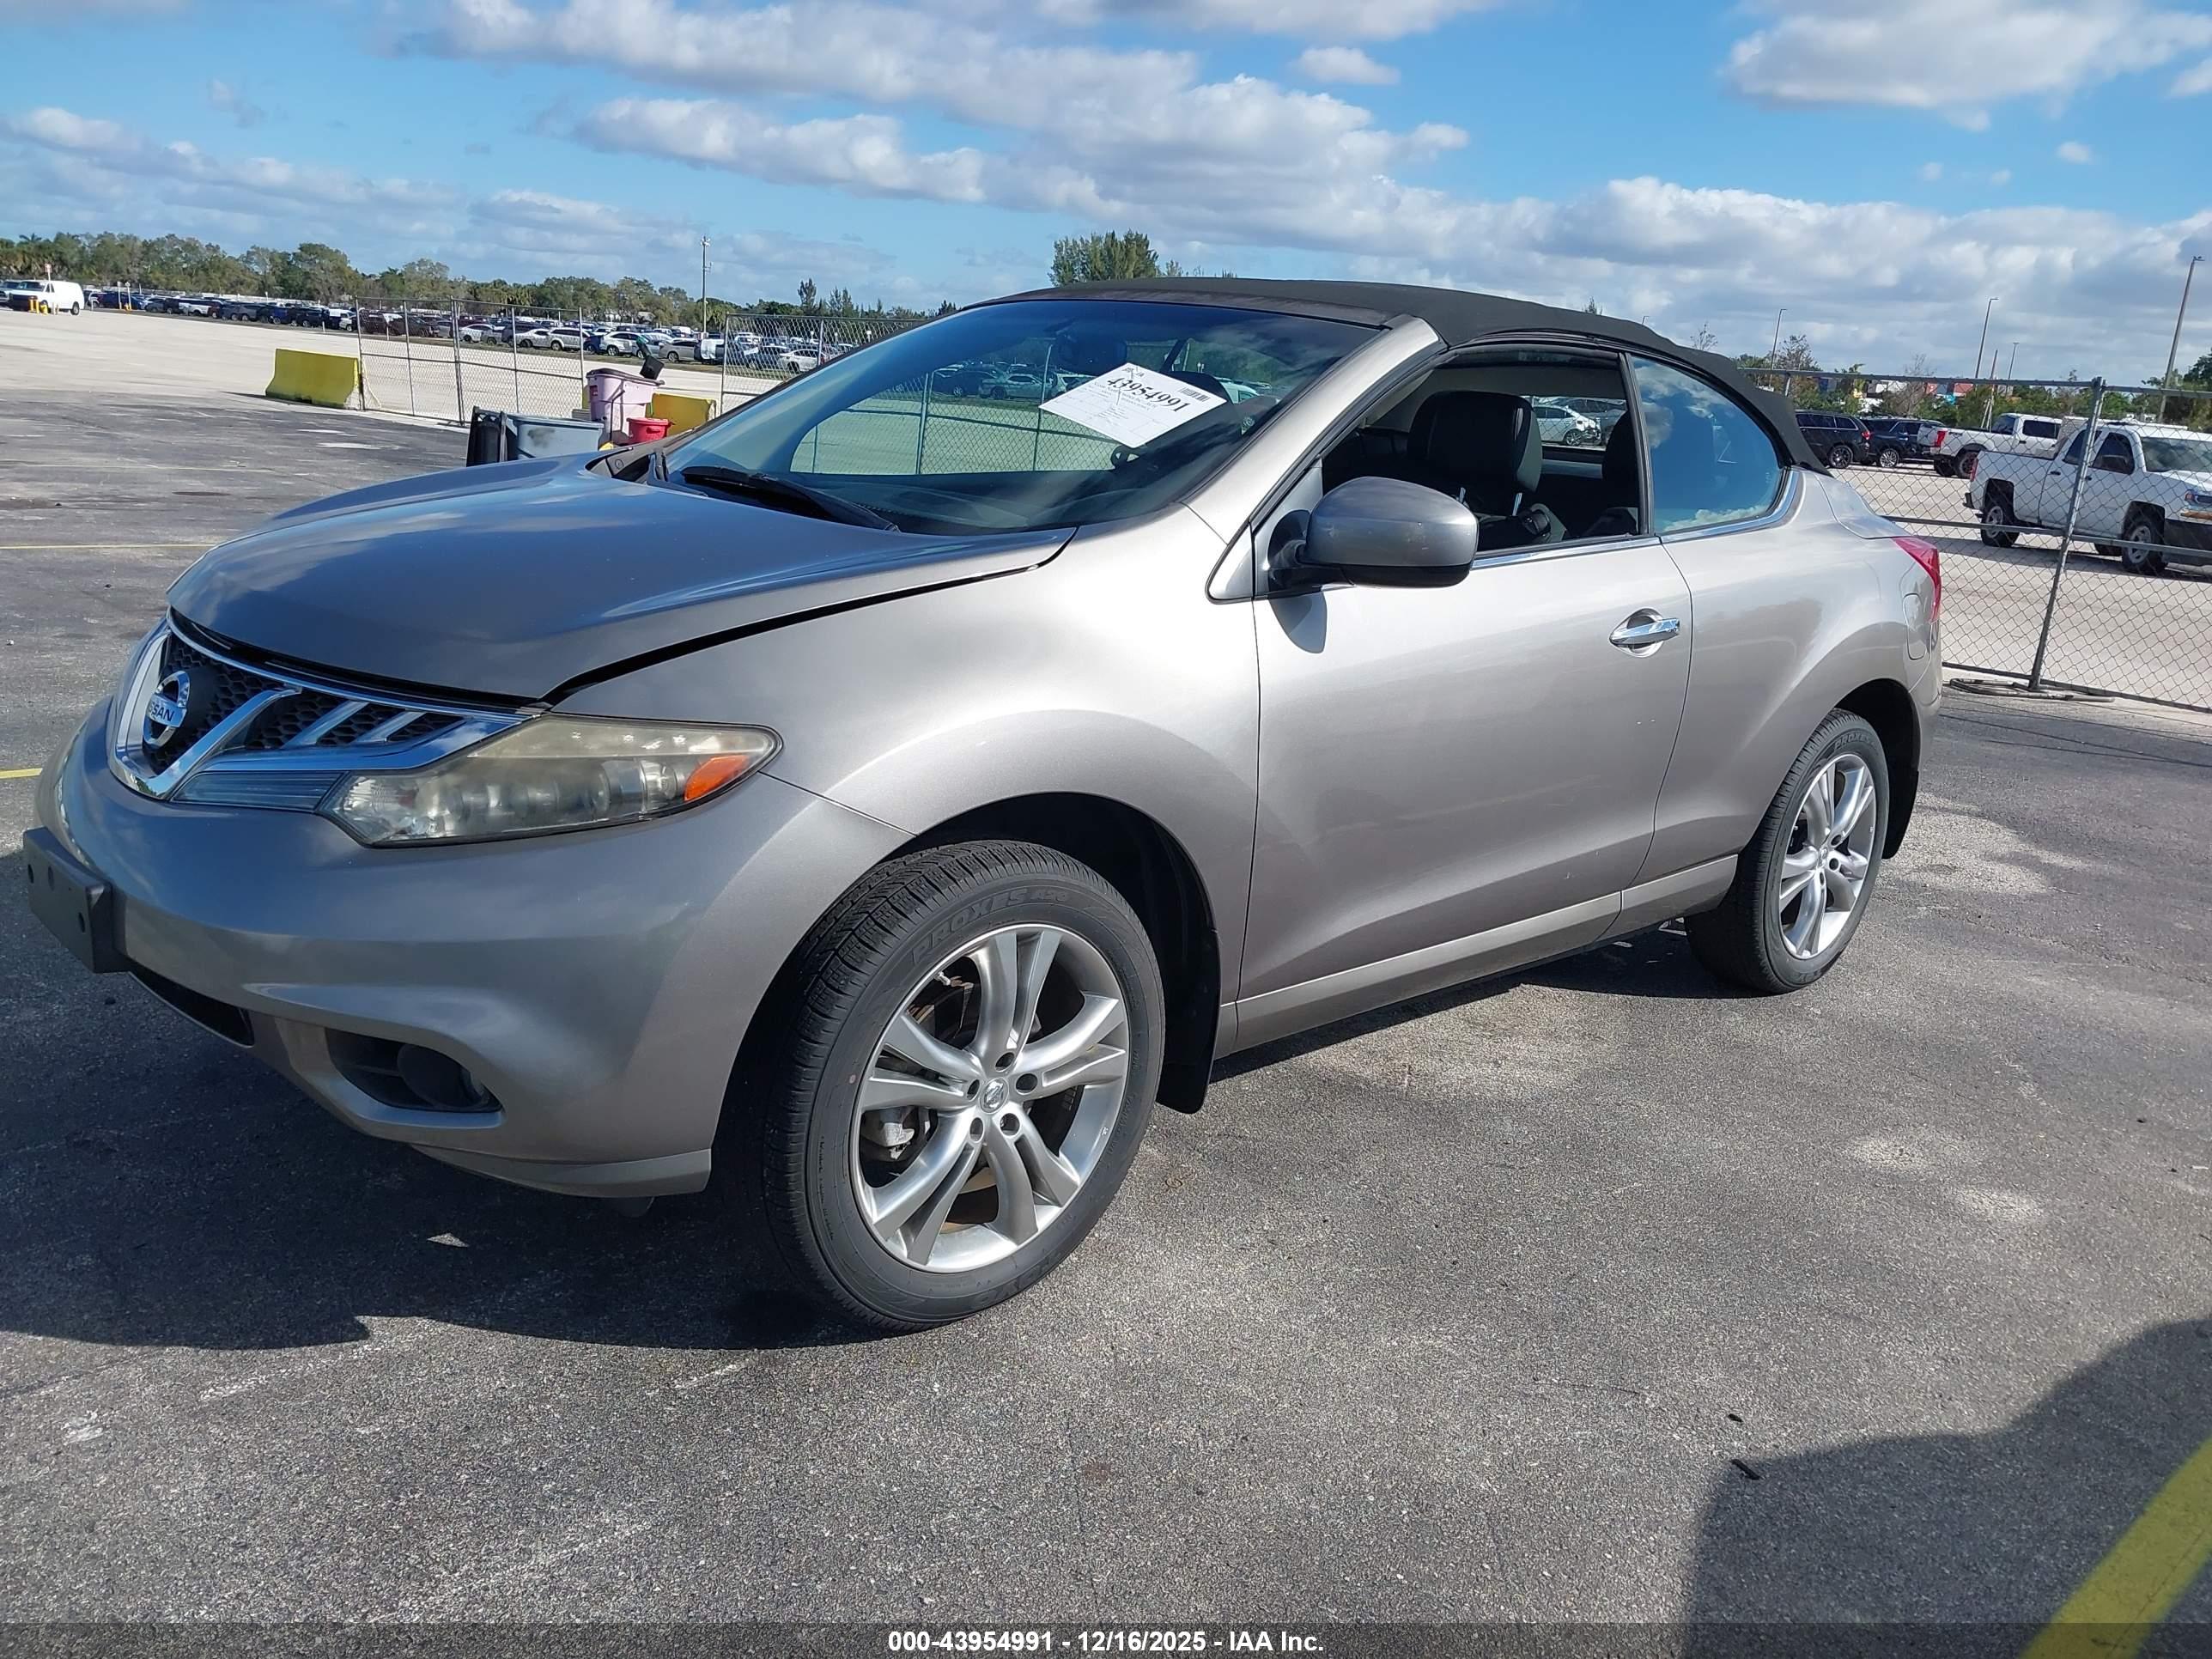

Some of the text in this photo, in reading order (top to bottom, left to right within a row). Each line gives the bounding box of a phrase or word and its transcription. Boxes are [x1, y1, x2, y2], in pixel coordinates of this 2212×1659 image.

[1107, 378, 1190, 412] 43954991
[149, 701, 175, 722] SSAN
[912, 889, 1028, 963] PROXES
